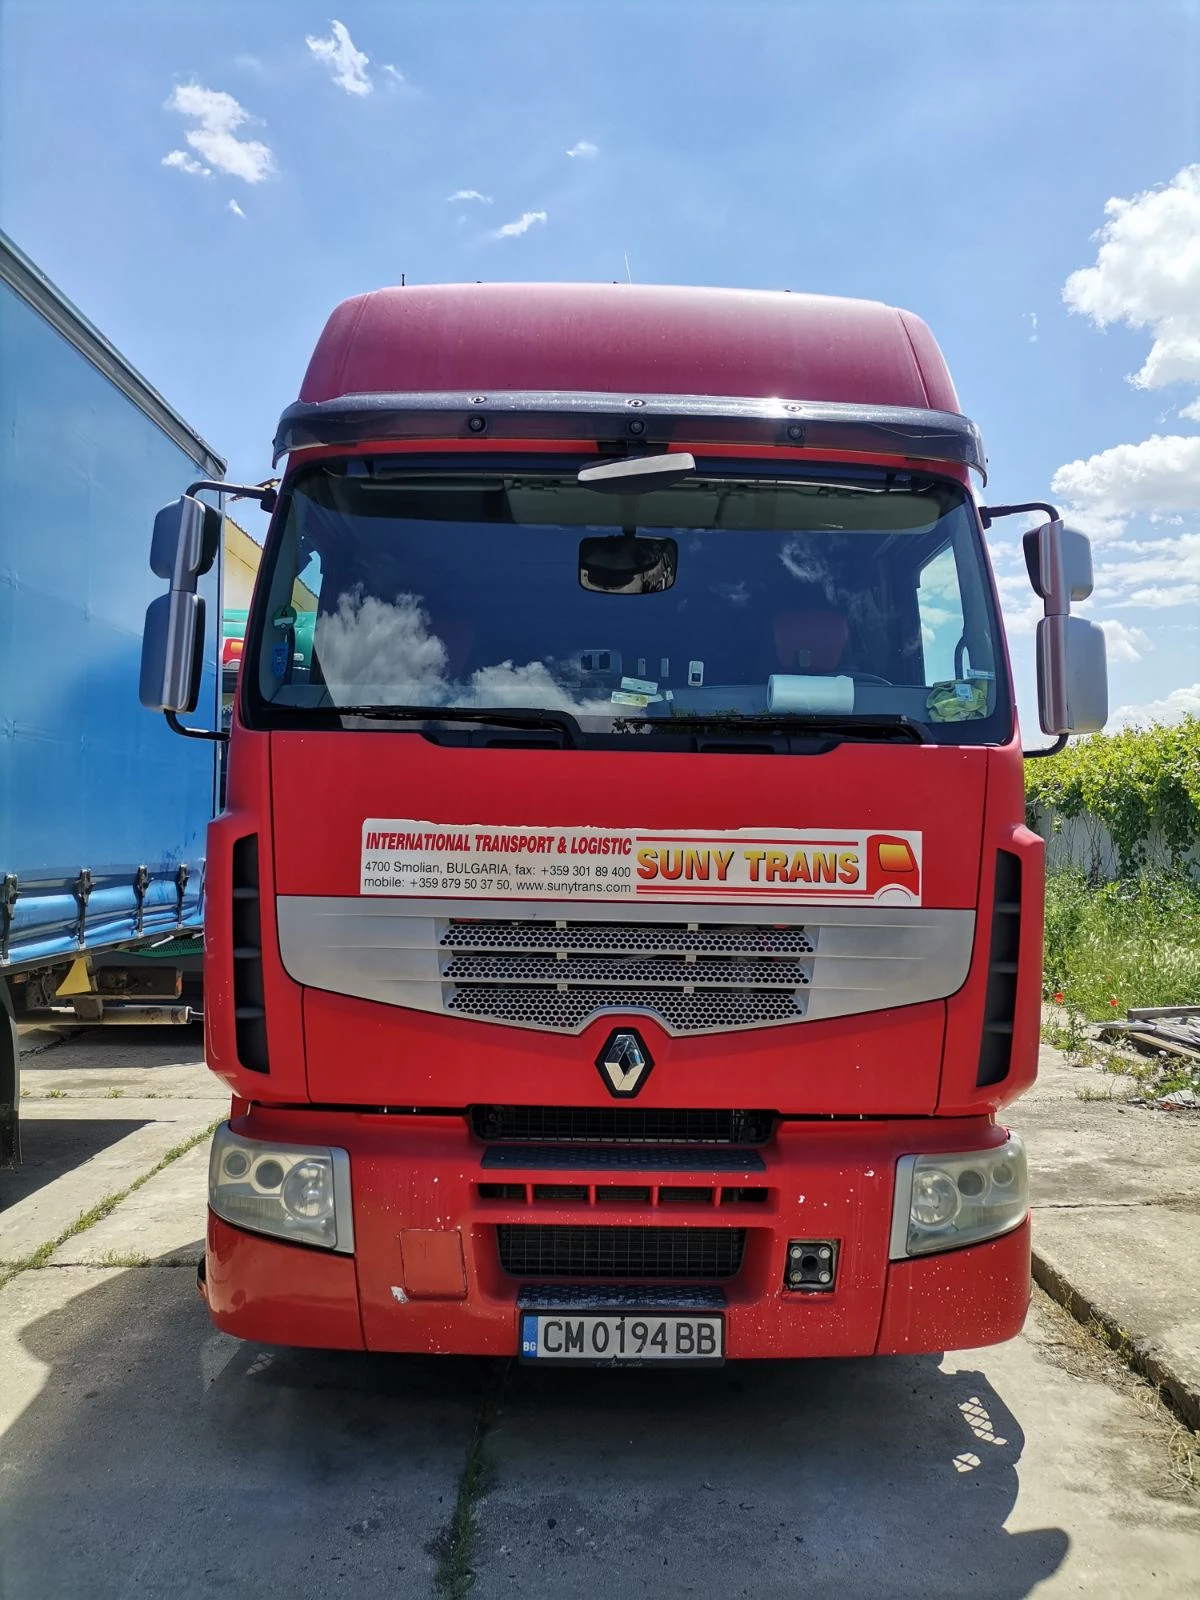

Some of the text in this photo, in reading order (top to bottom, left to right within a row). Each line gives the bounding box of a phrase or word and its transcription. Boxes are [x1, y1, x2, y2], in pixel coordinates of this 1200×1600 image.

[365, 832, 633, 855] INTERNATIONAL TRANSPORT & LOGISTIC
[365, 861, 631, 878] 4700 Smolian, BULGARIA, fax: +359 301 89 400
[636, 848, 859, 884] SUNY TRANS
[364, 876, 632, 894] mobile: +359 879 50 37 50, www.sunytrans.com
[522, 1341, 537, 1352] BG
